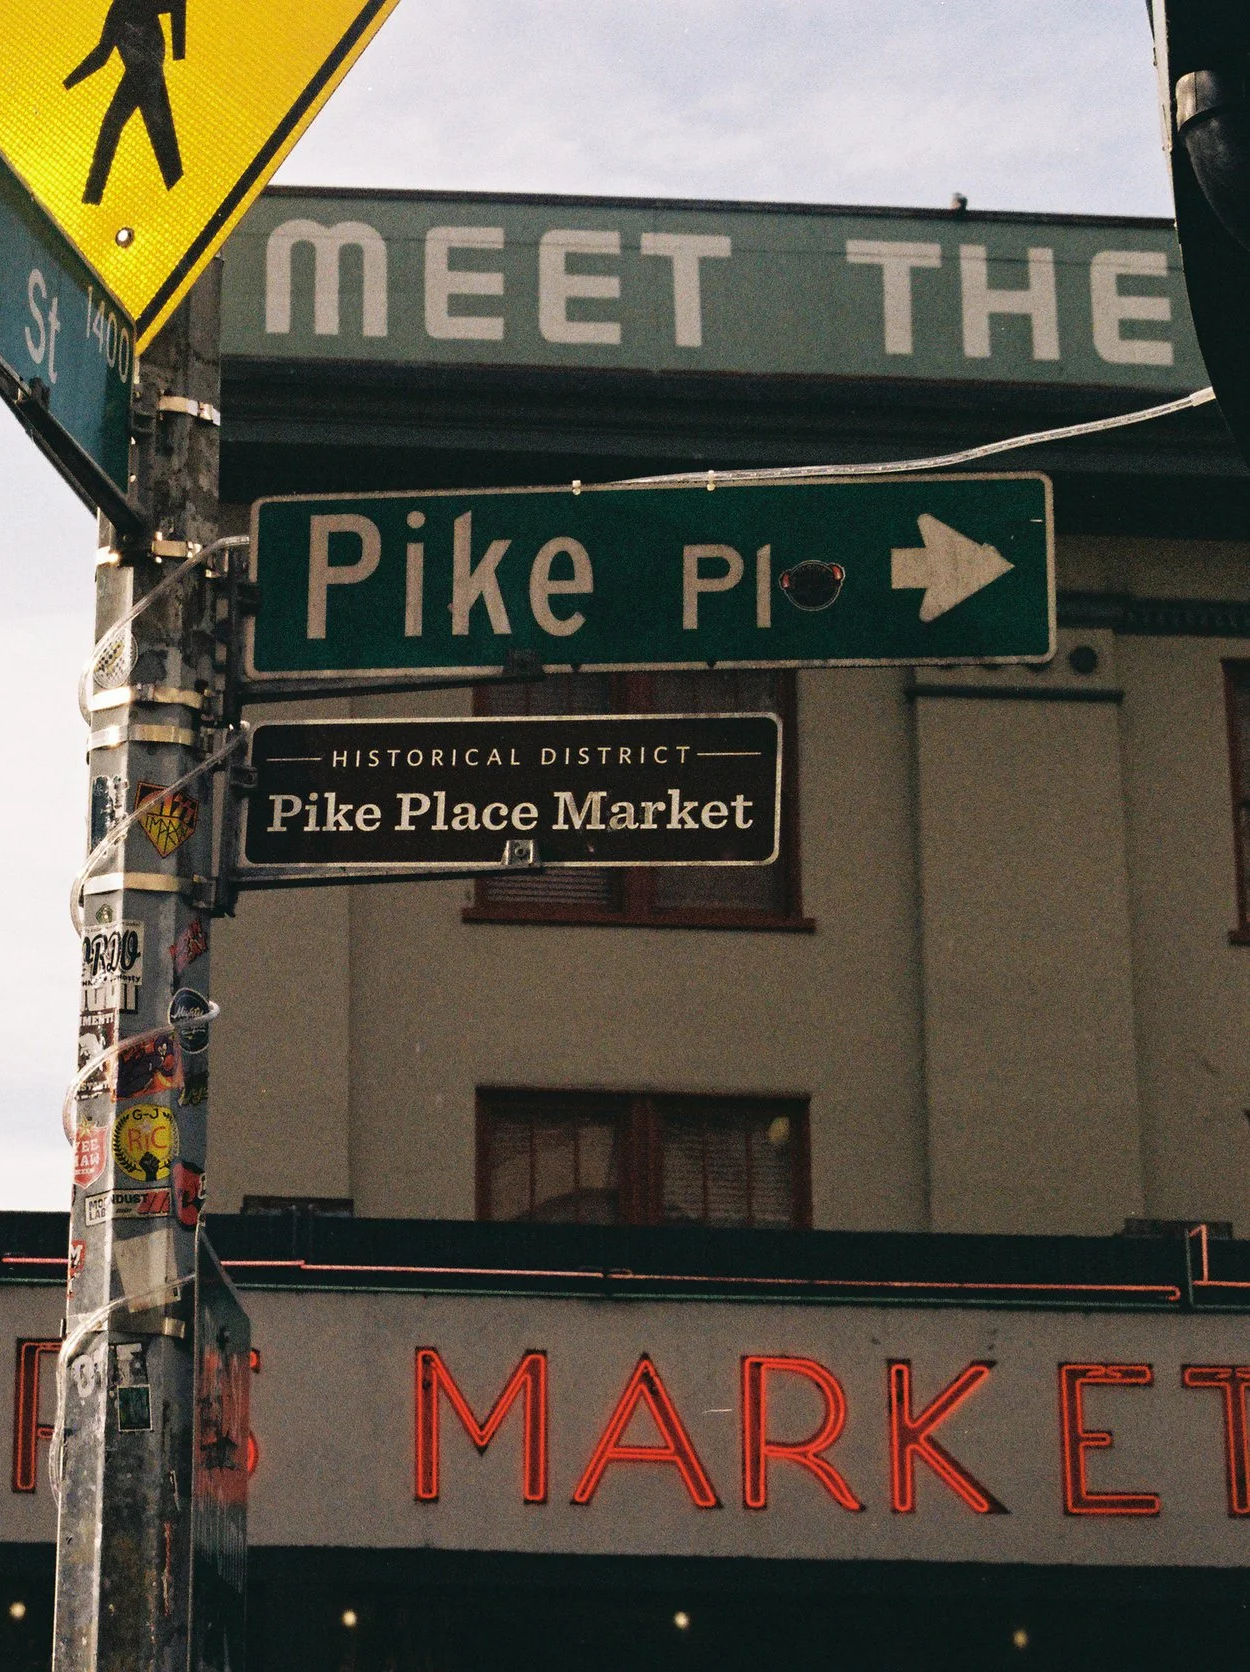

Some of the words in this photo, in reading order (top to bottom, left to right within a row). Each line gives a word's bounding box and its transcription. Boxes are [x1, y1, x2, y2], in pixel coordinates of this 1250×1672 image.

[24, 268, 62, 385] St
[86, 284, 130, 384] 1400
[263, 218, 733, 349] MEET
[845, 238, 1175, 367] THE
[305, 509, 596, 640] Pike
[681, 542, 772, 631] Pl
[265, 792, 383, 833] Pike
[393, 789, 540, 832] Place
[551, 788, 755, 832] Market
[331, 747, 522, 768] HISTORICAL
[541, 745, 692, 766] DISTRICT
